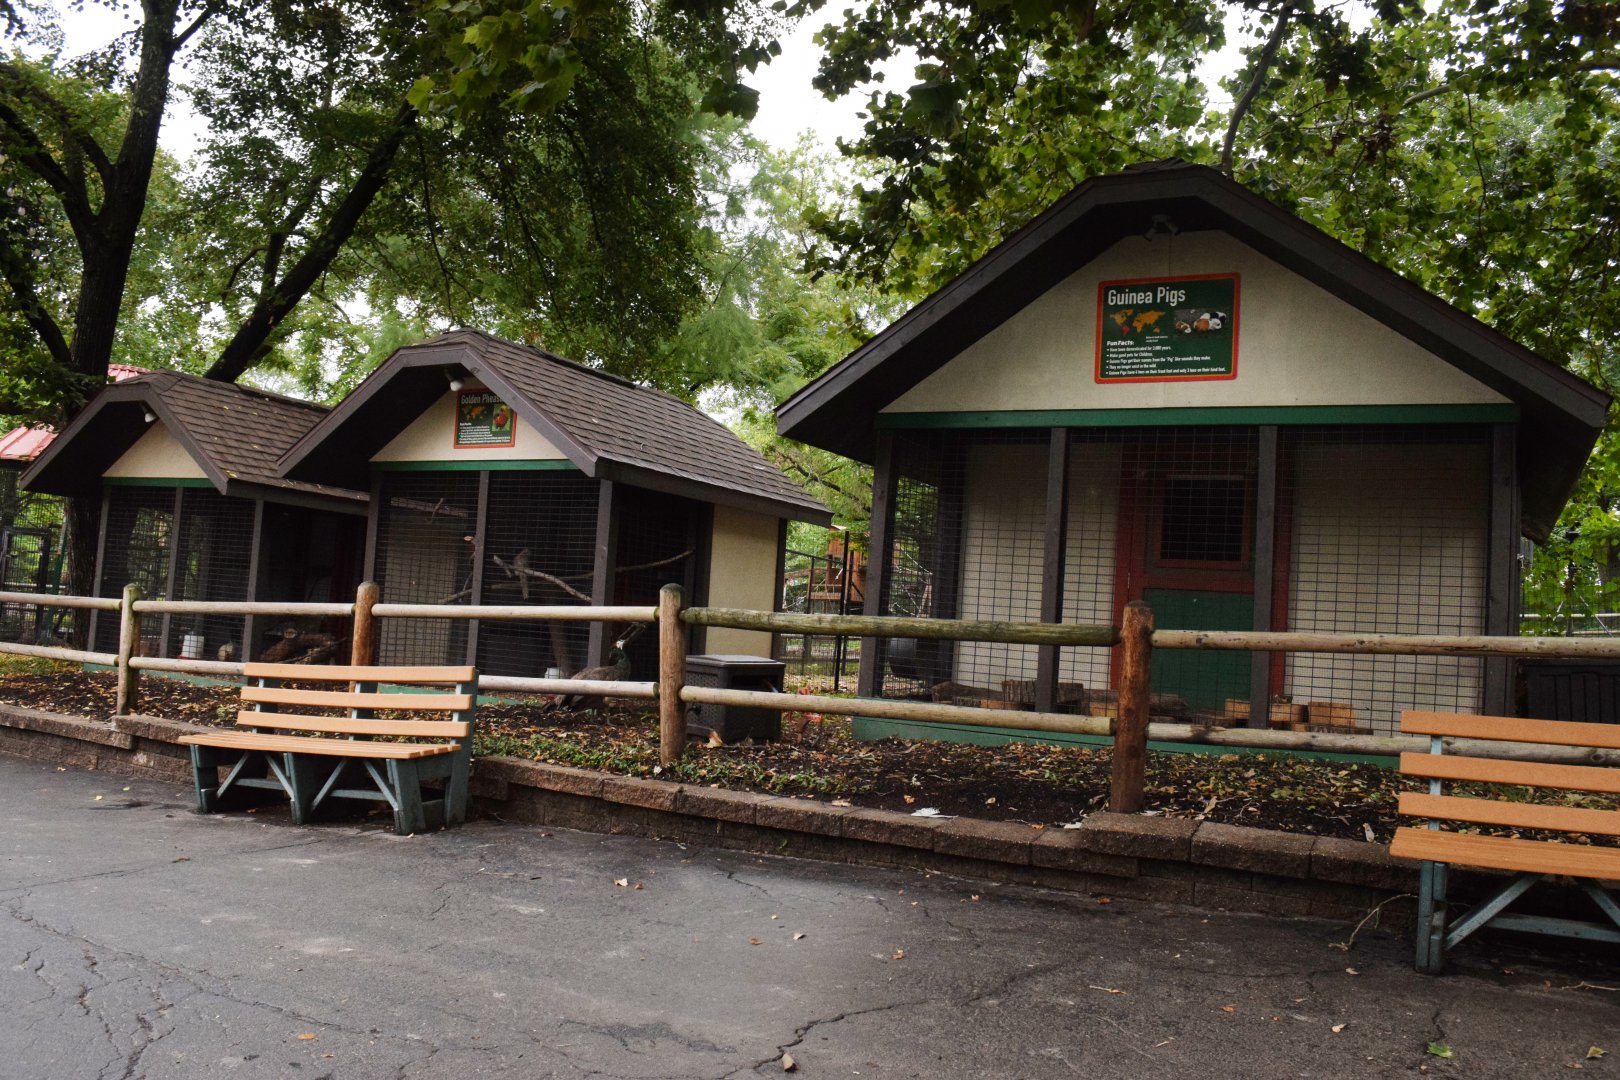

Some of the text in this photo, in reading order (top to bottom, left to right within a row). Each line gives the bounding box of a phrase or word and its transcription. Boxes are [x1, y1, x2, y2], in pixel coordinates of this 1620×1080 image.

[1108, 287, 1186, 306] Guinea Pigs
[461, 395, 480, 404] Golden
